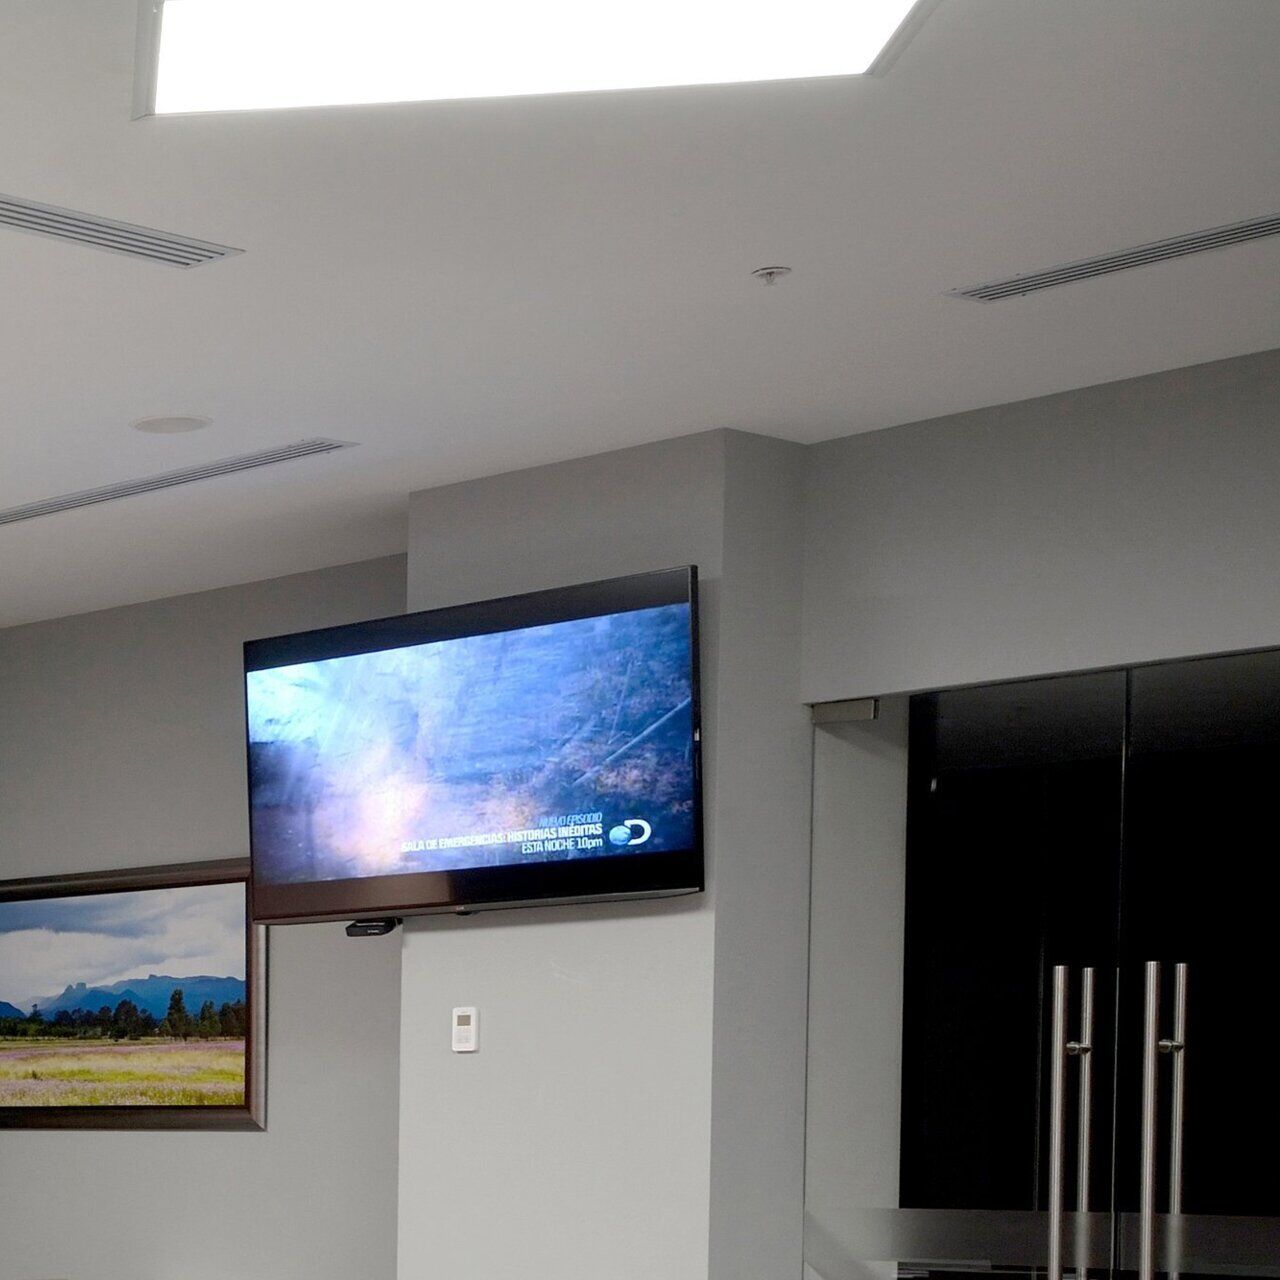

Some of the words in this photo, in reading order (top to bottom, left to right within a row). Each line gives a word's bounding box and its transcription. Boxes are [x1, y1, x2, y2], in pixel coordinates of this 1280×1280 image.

[567, 812, 603, 825] EPISODIO
[402, 840, 425, 853] SALA
[426, 839, 438, 850] DE
[507, 827, 556, 843] HISTORIAS
[557, 823, 603, 839] INÉDITAS
[521, 841, 543, 854] ESTA
[544, 839, 576, 852] NOCHE
[576, 837, 603, 850] 10pm
